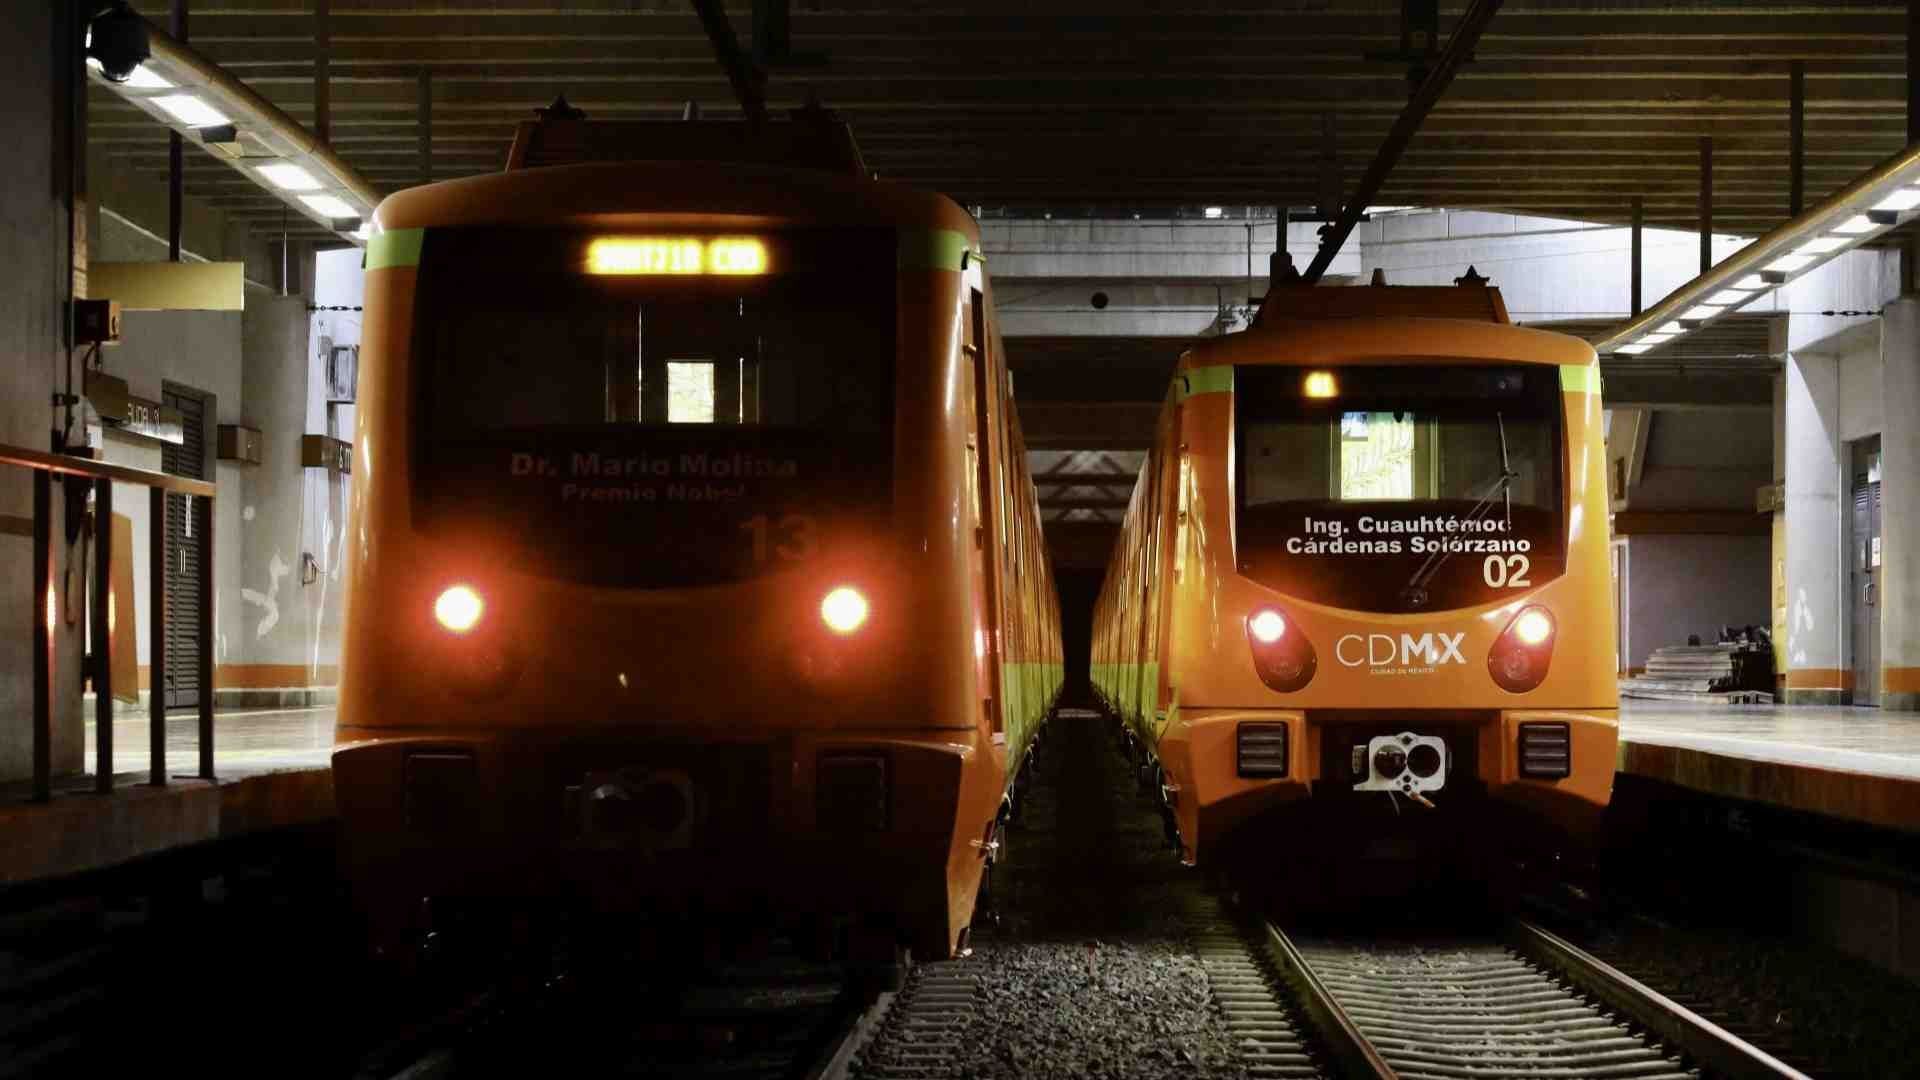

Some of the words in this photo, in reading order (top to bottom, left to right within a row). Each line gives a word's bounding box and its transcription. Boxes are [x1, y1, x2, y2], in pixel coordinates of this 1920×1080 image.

[510, 452, 558, 476] Dr.
[571, 452, 671, 476] Mario
[560, 483, 656, 503] Premio
[738, 513, 818, 562] 13
[1304, 516, 1350, 537] Ing.
[1357, 515, 1512, 534] Cuauhtémoc
[1286, 537, 1403, 555] Cárdenas
[1409, 536, 1531, 553] Solórzano
[1482, 554, 1532, 589] 02
[1336, 632, 1467, 667] CDMX
